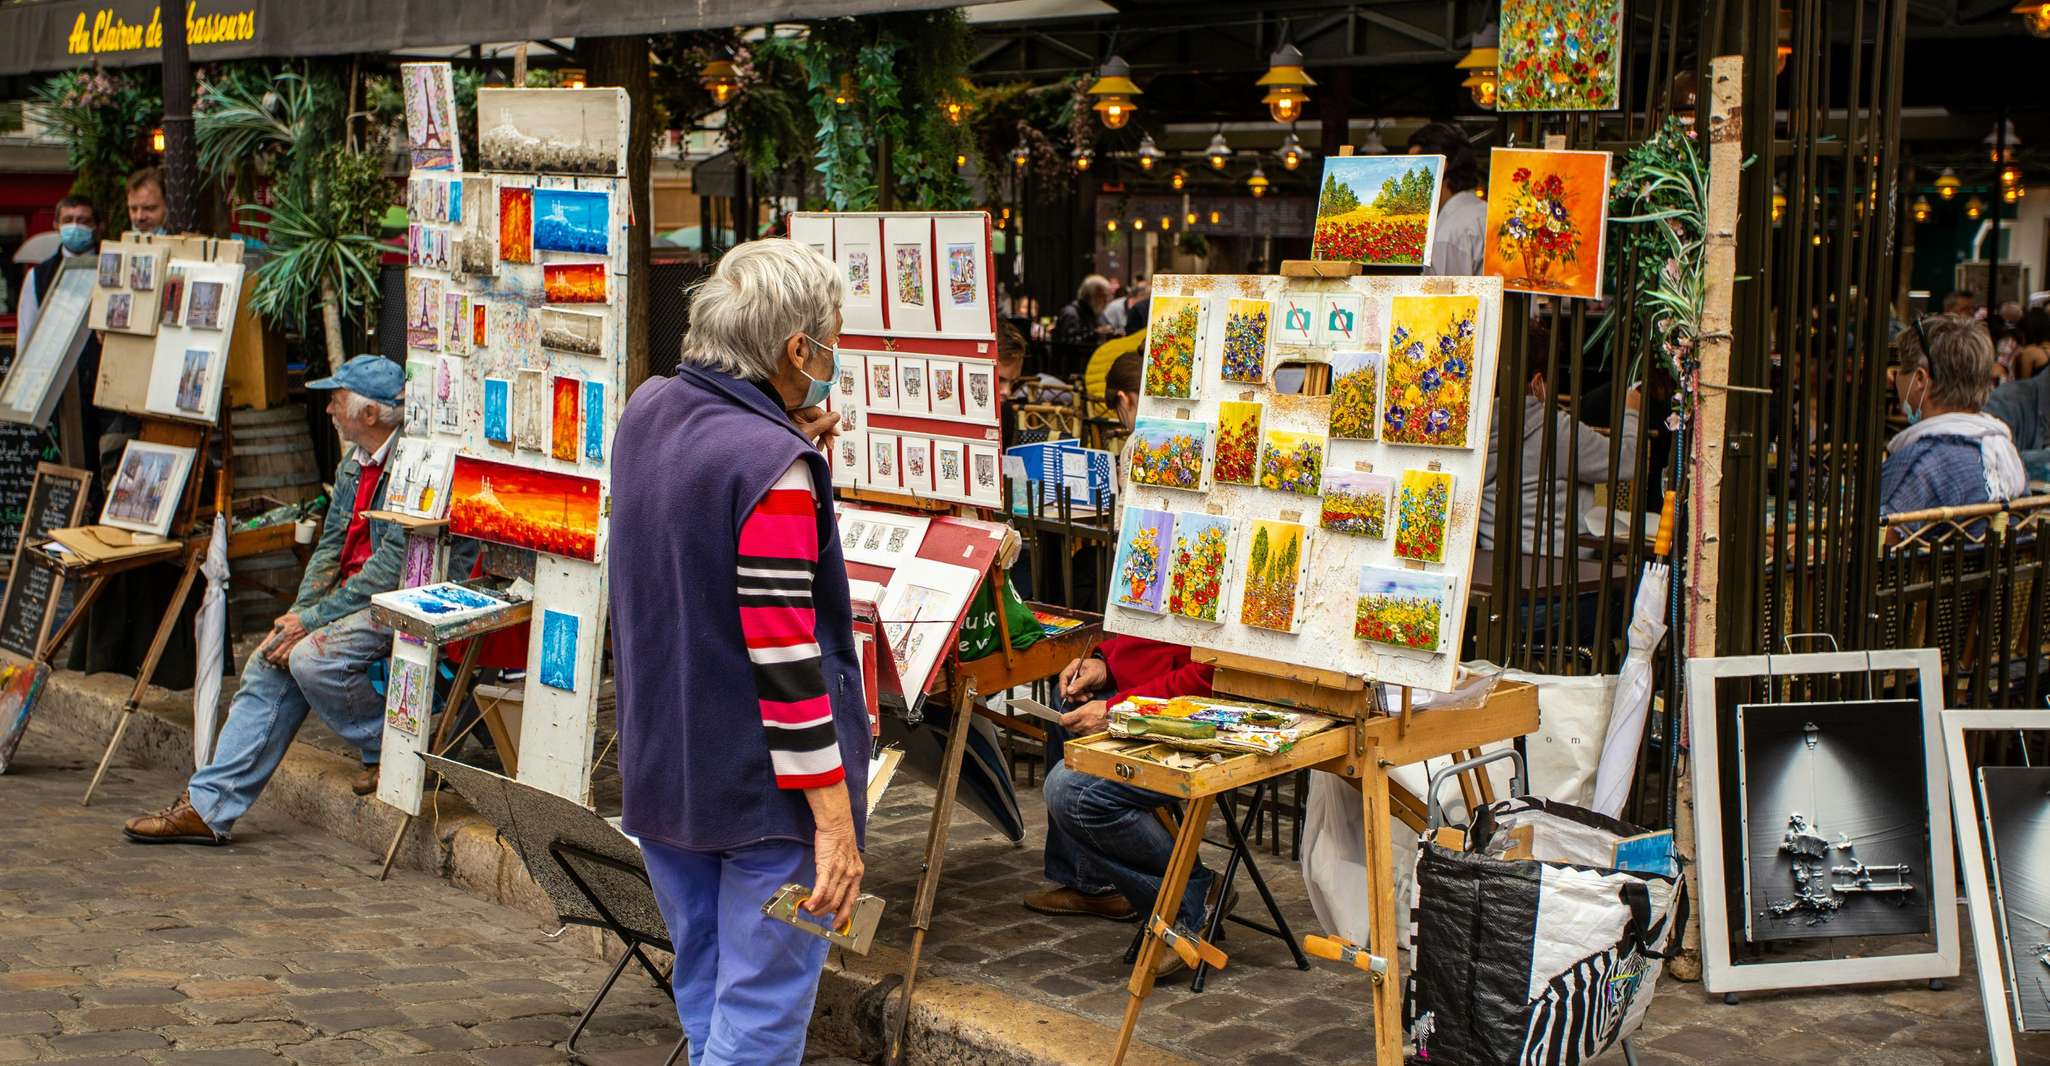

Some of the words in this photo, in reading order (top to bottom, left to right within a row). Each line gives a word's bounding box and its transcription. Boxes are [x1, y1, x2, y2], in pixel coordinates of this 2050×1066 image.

[67, 11, 89, 54] Au
[92, 8, 143, 53] Clairon
[145, 6, 163, 48] de
[186, 0, 255, 45] hasseurs
